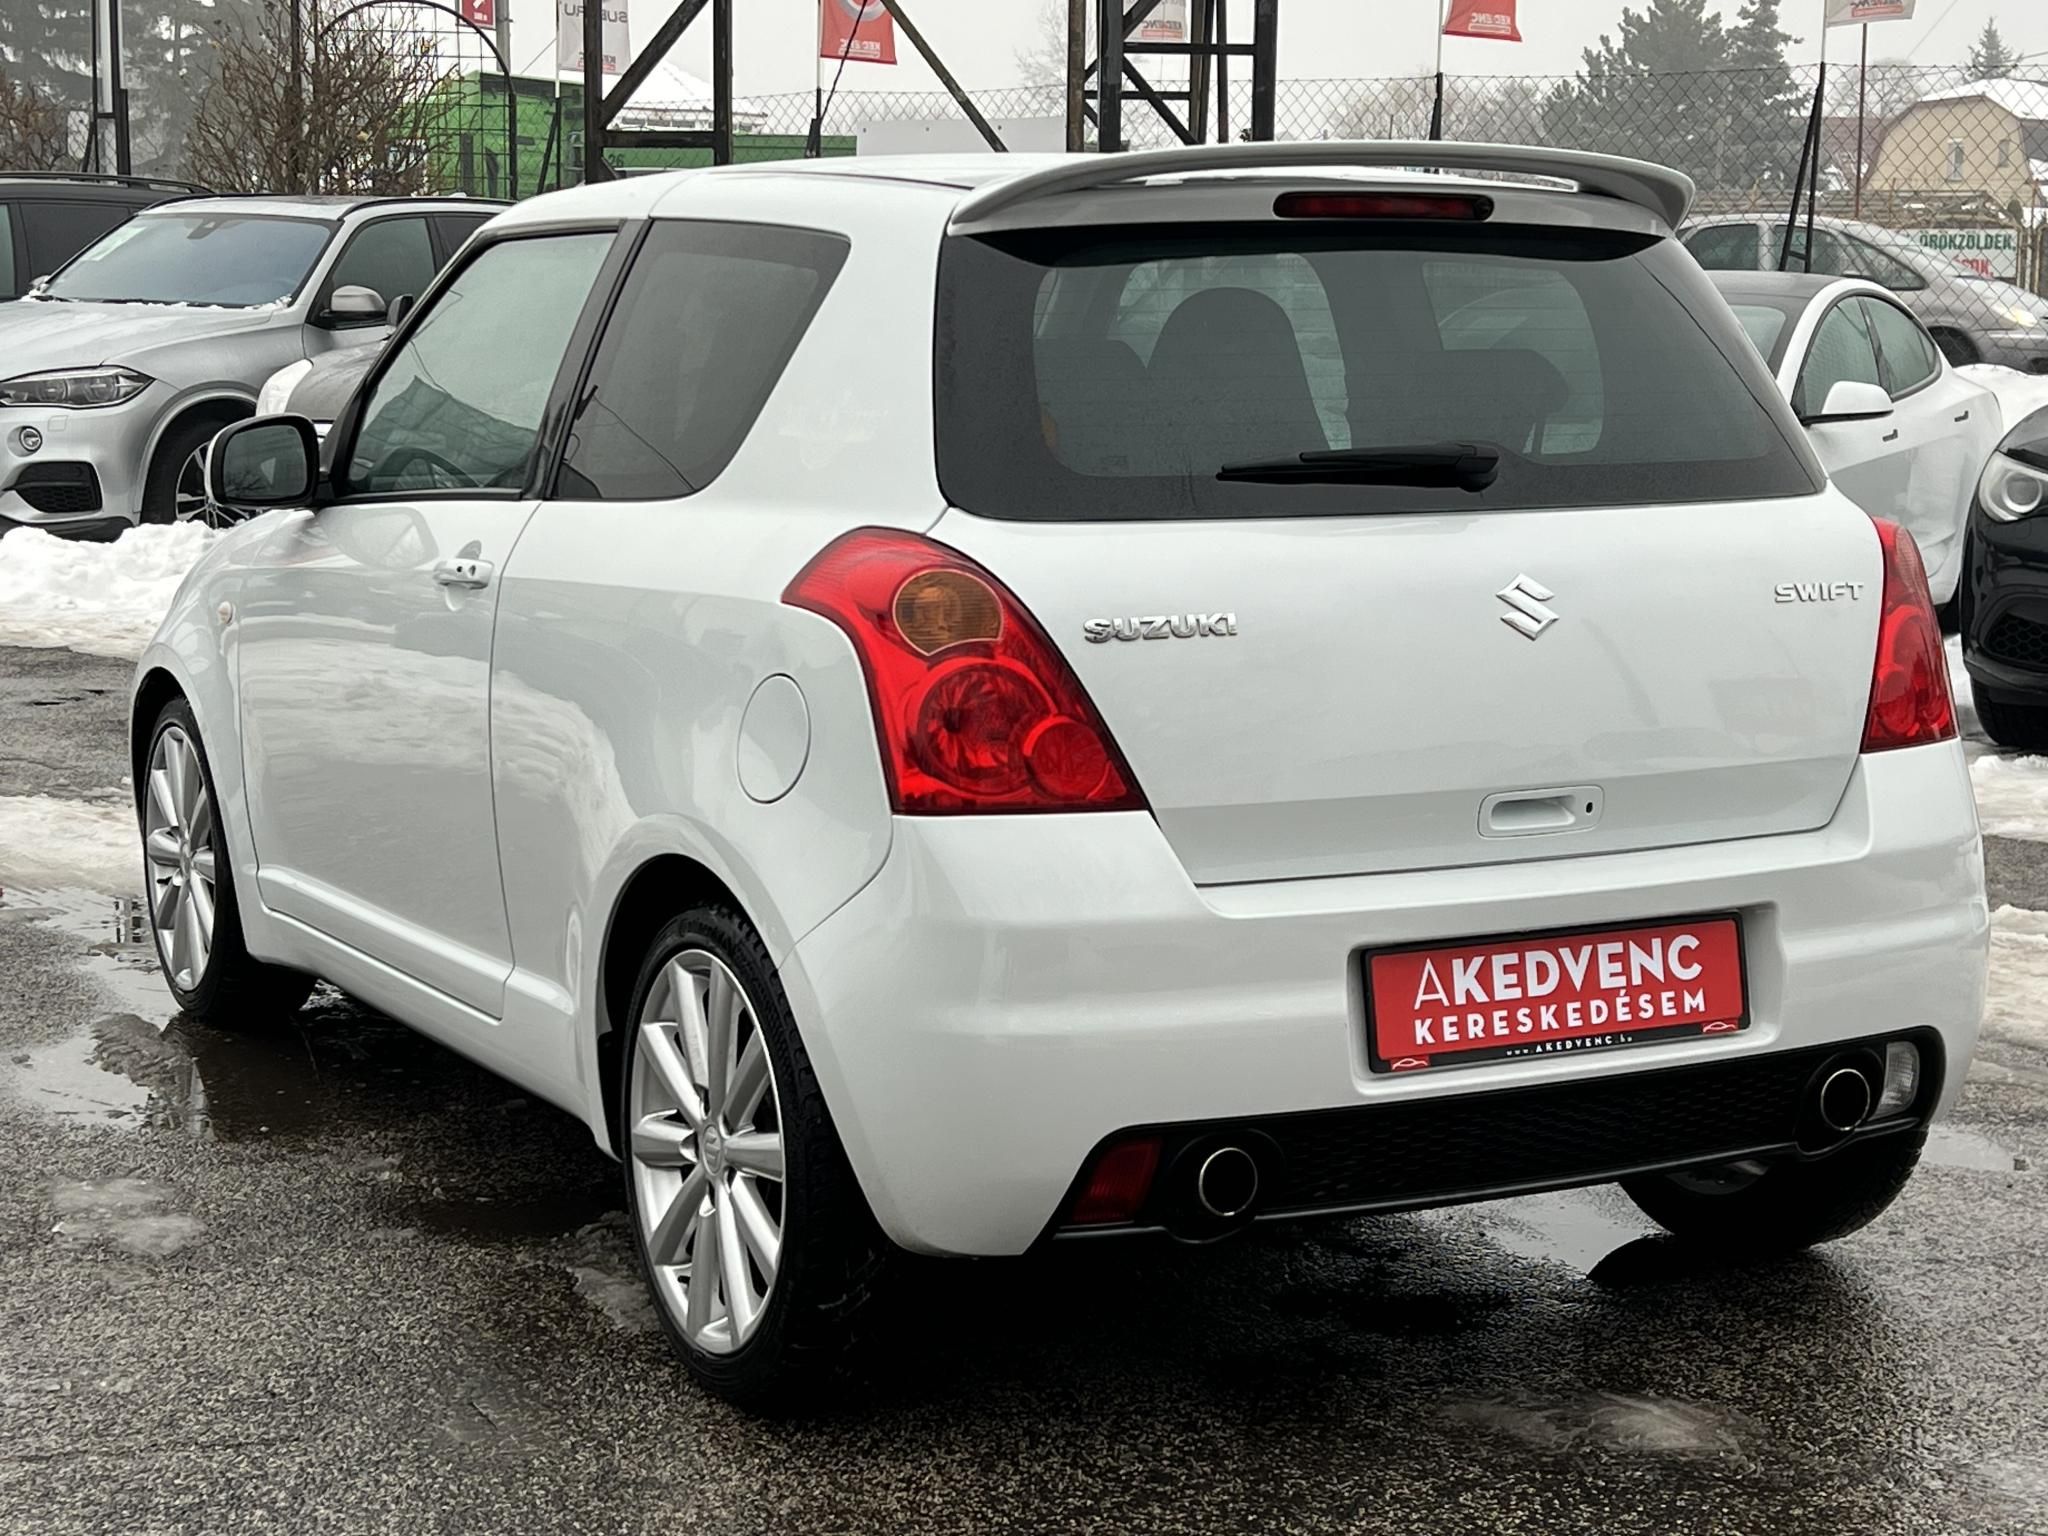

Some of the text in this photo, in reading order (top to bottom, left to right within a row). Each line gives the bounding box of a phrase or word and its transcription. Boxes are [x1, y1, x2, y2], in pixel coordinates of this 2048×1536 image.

[1775, 581, 1864, 603] SWIFT
[1084, 612, 1238, 644] SUZUKI
[1414, 987, 1706, 1045] KERESKEDÉSEM
